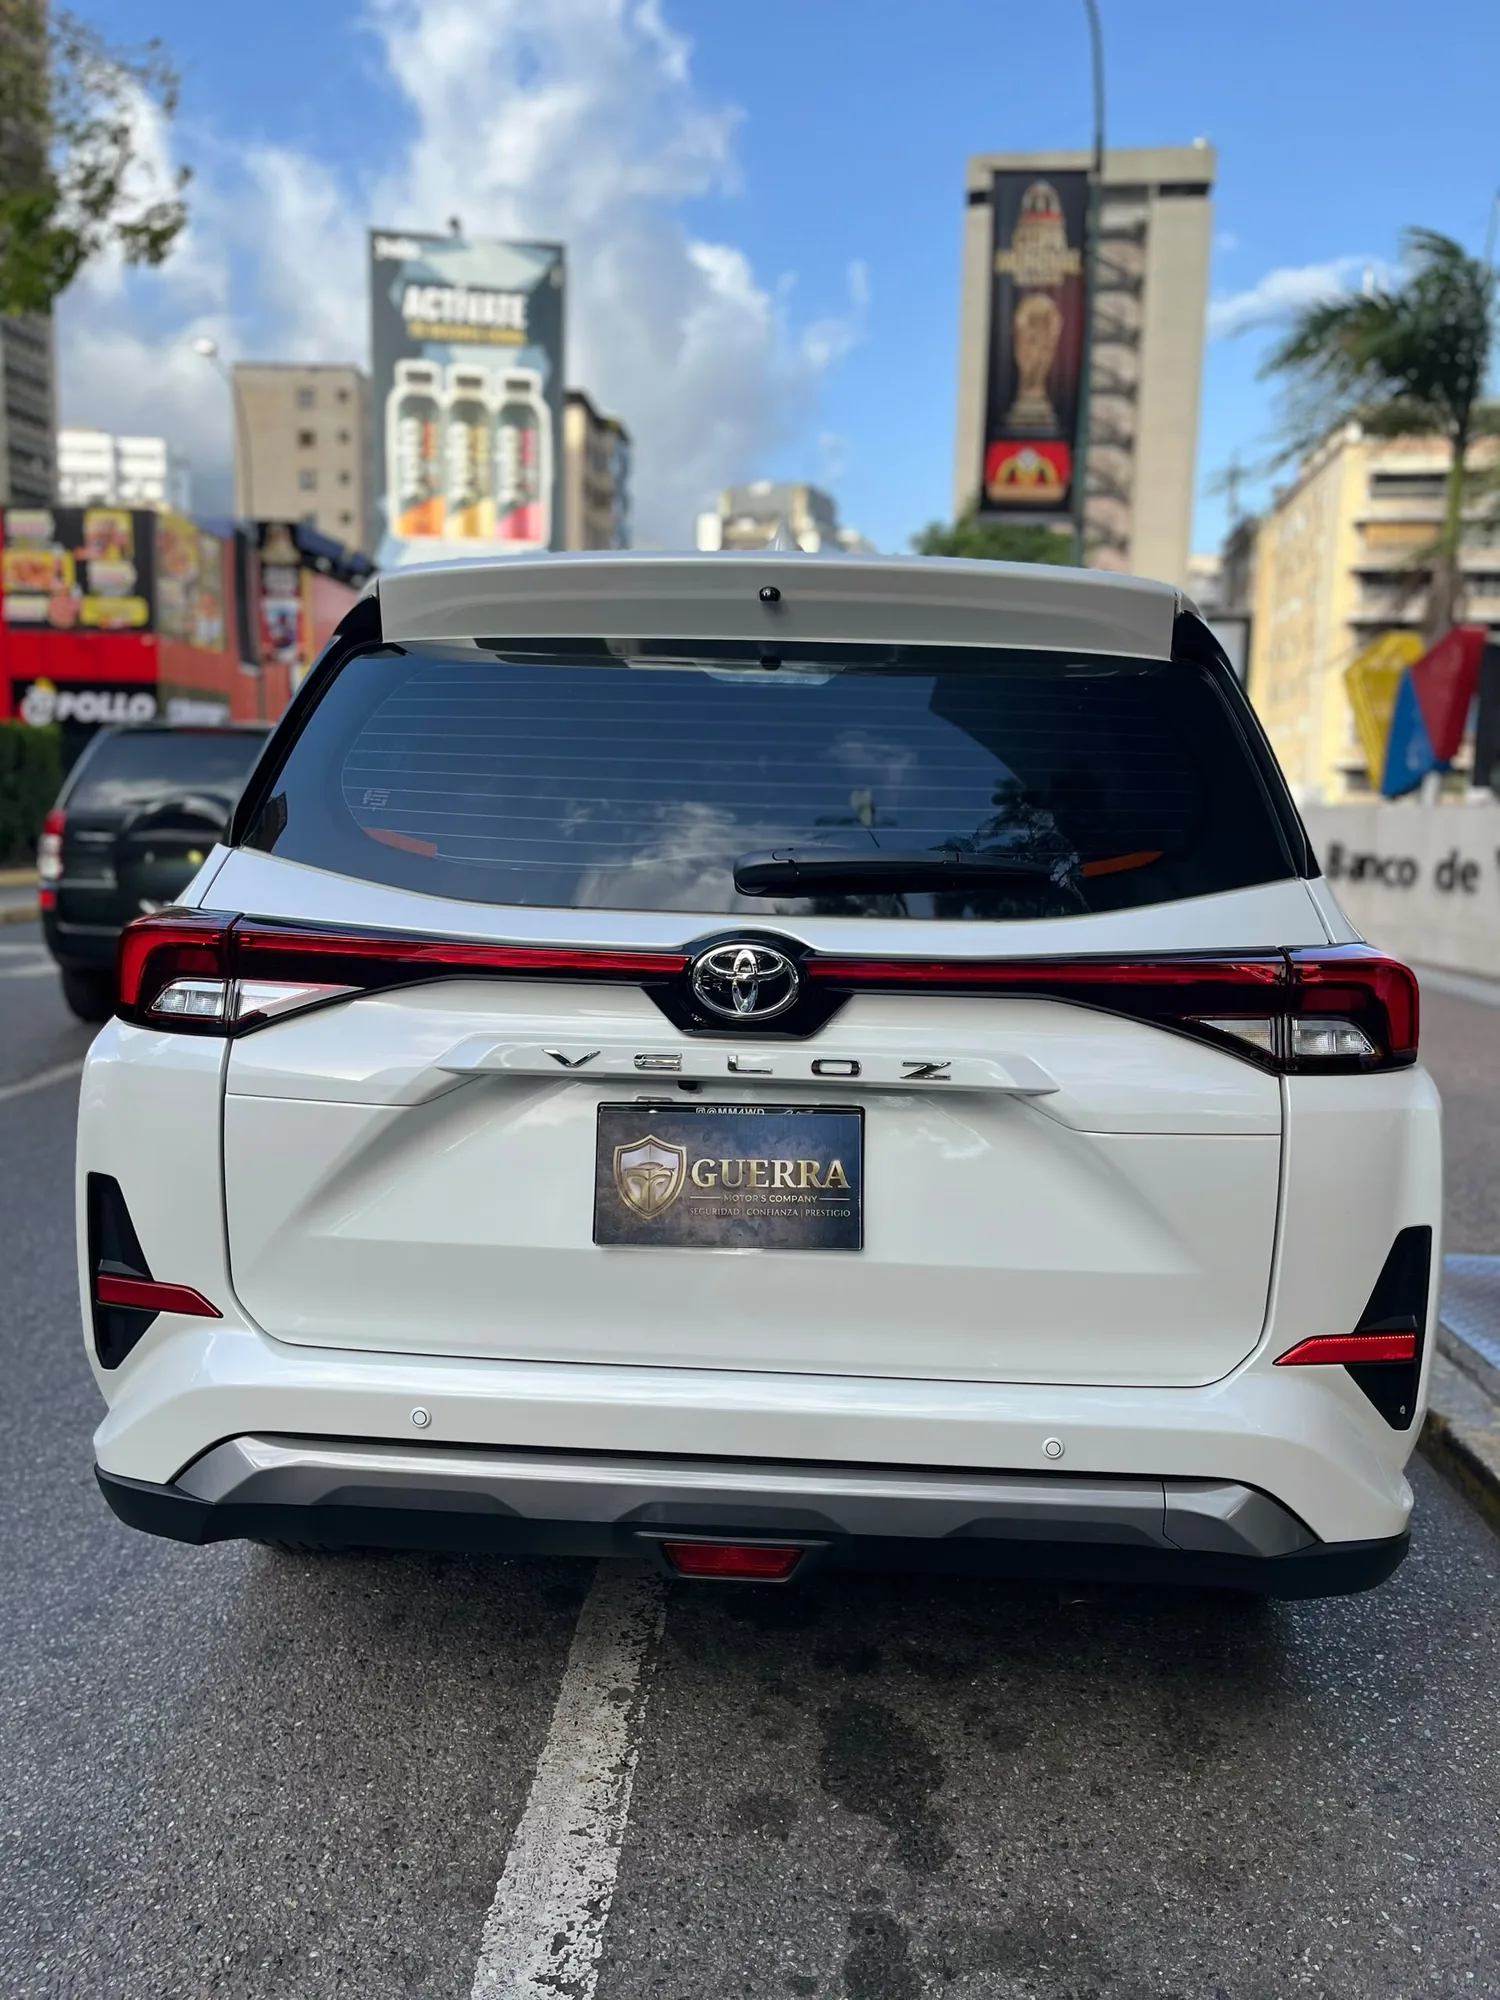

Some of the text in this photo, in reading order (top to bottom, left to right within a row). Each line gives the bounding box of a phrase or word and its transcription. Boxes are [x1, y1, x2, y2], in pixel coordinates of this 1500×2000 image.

[1434, 848, 1480, 895] de
[541, 1047, 952, 1081] VELOZ
[690, 1158, 851, 1189] GUERRA
[689, 1207, 851, 1218] SEGURIDAD CONFIANZA PRESTIGIO
[769, 1195, 818, 1204] COMPANY
